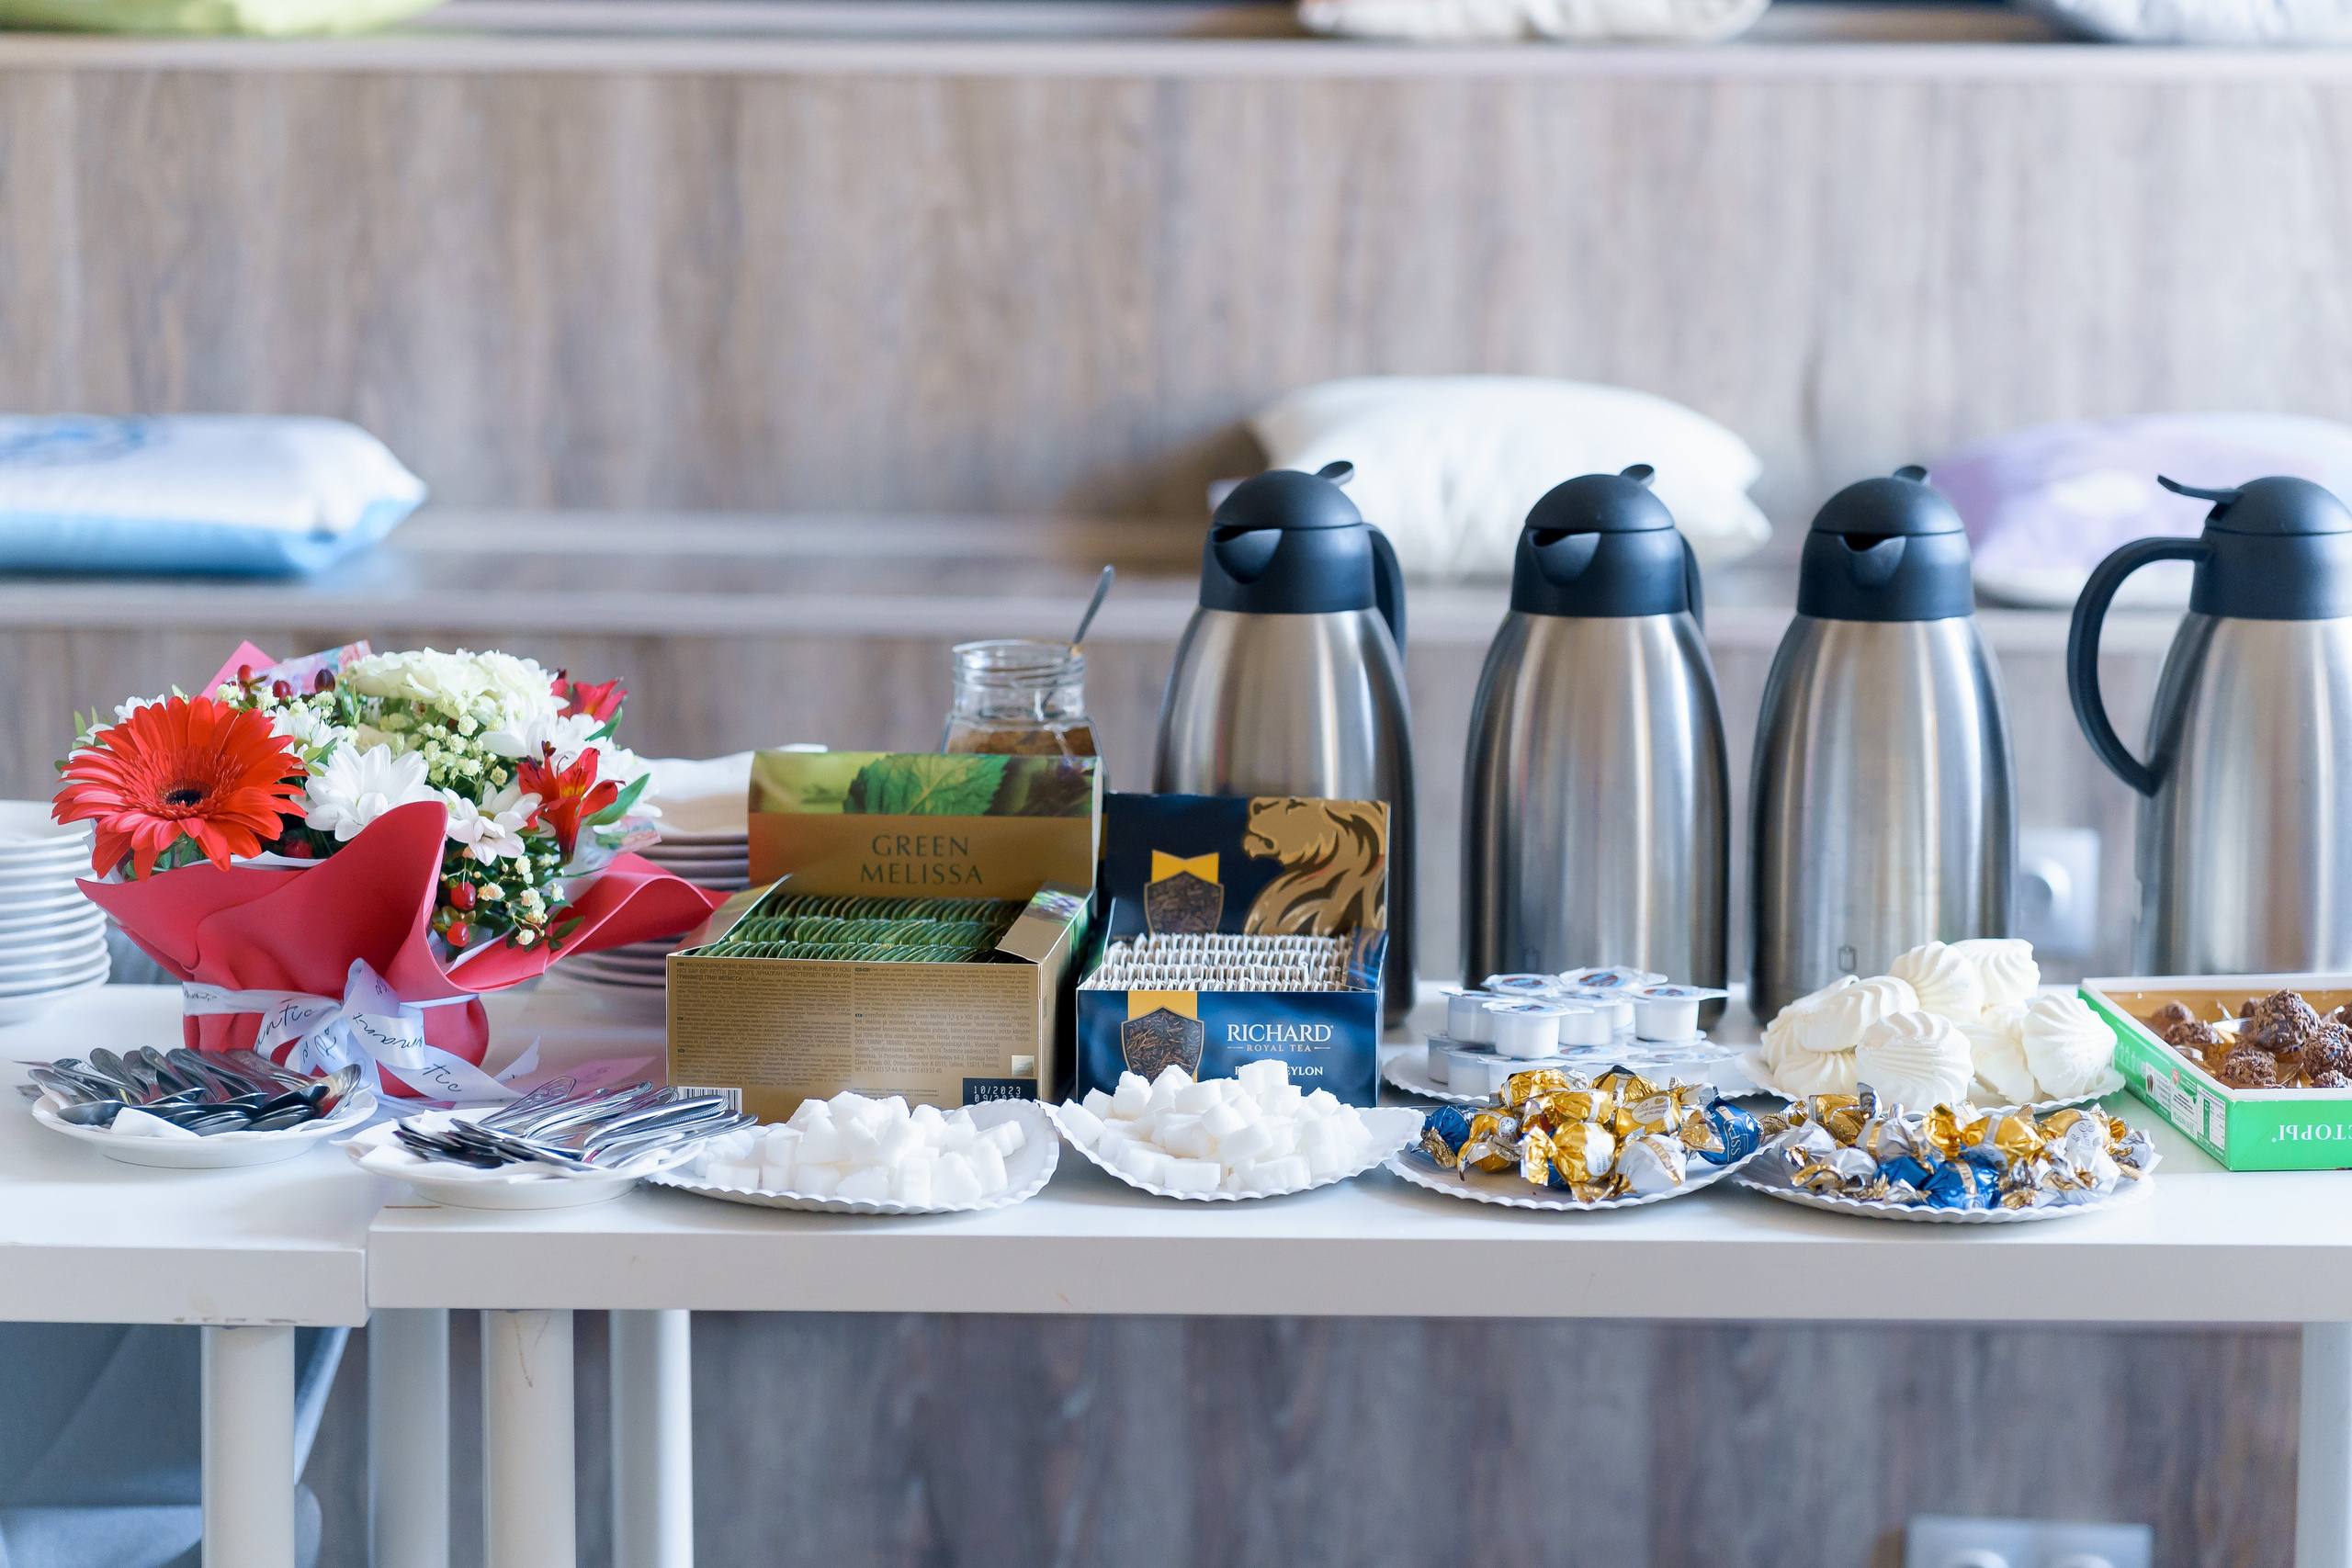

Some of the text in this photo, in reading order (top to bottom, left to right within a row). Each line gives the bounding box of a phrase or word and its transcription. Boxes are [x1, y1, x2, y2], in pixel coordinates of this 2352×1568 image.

[872, 834, 968, 858] GREEN
[860, 863, 983, 886] MELISSA
[1227, 1023, 1332, 1043] RICHARD
[1246, 1043, 1312, 1053] ROYAL TEA
[1286, 1066, 1324, 1076] EYLON
[974, 1085, 1021, 1095] 10/2023
